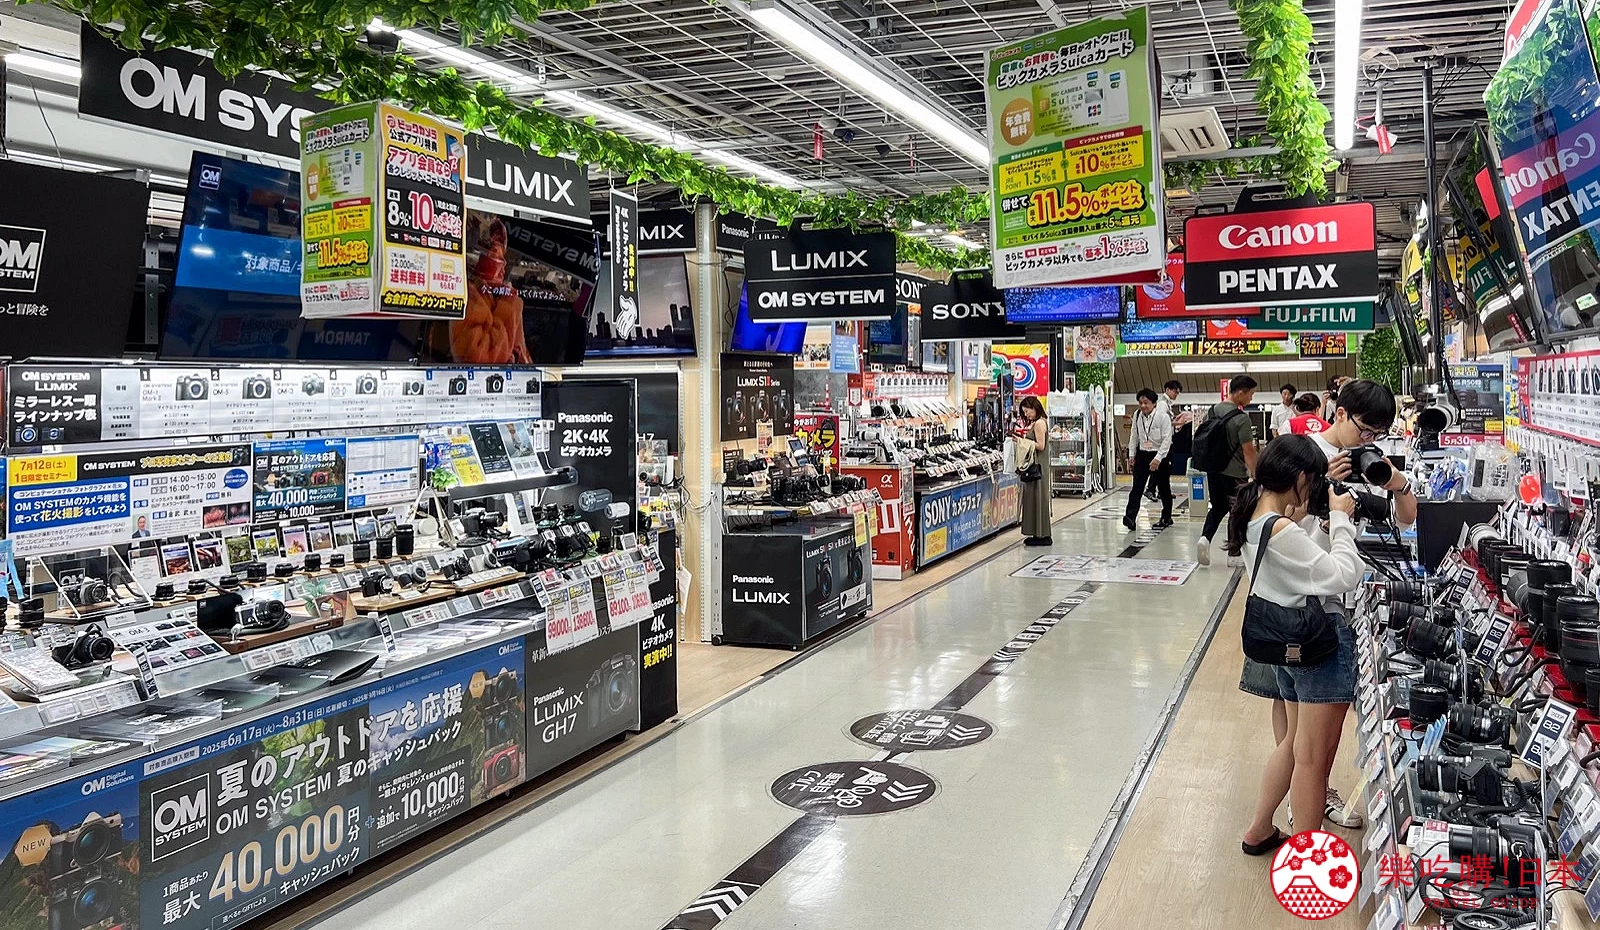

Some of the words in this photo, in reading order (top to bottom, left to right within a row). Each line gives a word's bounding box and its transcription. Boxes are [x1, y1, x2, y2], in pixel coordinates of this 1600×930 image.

[998, 42, 1133, 88] ビックカメラSuicaカード
[119, 57, 206, 122] OM
[397, 119, 438, 140] ビックカメラ
[389, 147, 452, 178] アプリ会員なら
[1110, 160, 1134, 168] サービス
[465, 158, 575, 207] LUMIX
[1101, 183, 1138, 198] ポイント
[1033, 186, 1100, 220] 11.5%
[1101, 195, 1140, 210] サービス
[721, 223, 750, 238] Panasonic
[1218, 220, 1338, 250] Canon
[771, 249, 868, 272] LUMIX
[1005, 255, 1083, 271] ビックカメラ以外でも
[391, 269, 426, 286] 送料無料
[1219, 263, 1338, 294] PENTAX
[758, 291, 788, 309] OM
[791, 289, 885, 307] SYSTEM
[896, 279, 927, 299] SON
[932, 302, 1004, 320] SONY
[1264, 307, 1356, 323] FUJIFILM
[22, 372, 41, 381] OM
[41, 371, 90, 381] SYSTEM
[35, 381, 77, 392] LUMIX
[13, 394, 96, 408] ミラーレス一眼
[13, 409, 97, 423] ラインナップ表
[558, 412, 613, 424] Panasonic
[560, 445, 612, 457] ビデオカメラ
[20, 460, 67, 471] 7月12日(土)
[83, 462, 98, 471] OM
[98, 460, 136, 469] SYSTEM
[15, 502, 31, 512] OM
[267, 488, 308, 507] 40,000
[15, 504, 127, 524] 使って花火撮影をしてみよう
[925, 495, 951, 529] SONY
[951, 492, 982, 517] カメラフェア
[732, 574, 774, 584] Panasonic
[731, 588, 791, 605] LUMIX
[651, 613, 667, 633] 4K
[642, 628, 674, 651] ビデオカメラ
[533, 686, 566, 706] Panasonic
[533, 690, 585, 727] LUMIX
[542, 712, 578, 744] GH7
[1543, 719, 1561, 734] 82
[216, 682, 464, 807] 夏のアウトドアを応援
[105, 769, 127, 781] Digital
[105, 774, 135, 789] Solutions
[216, 804, 249, 835] OM
[255, 772, 332, 820] SYSTEM
[336, 720, 463, 787] 夏のキャッシュバック
[81, 775, 106, 796] OM
[400, 770, 459, 820] 10,000
[154, 789, 207, 833] OM
[426, 794, 465, 818] キャッシュバック
[154, 818, 207, 847] SYSTEM
[22, 838, 47, 854] NEW
[162, 890, 201, 925] 最大
[209, 804, 344, 902] 40,000
[279, 846, 360, 896] キャッシュバック
[162, 871, 209, 897] 1商品あたり
